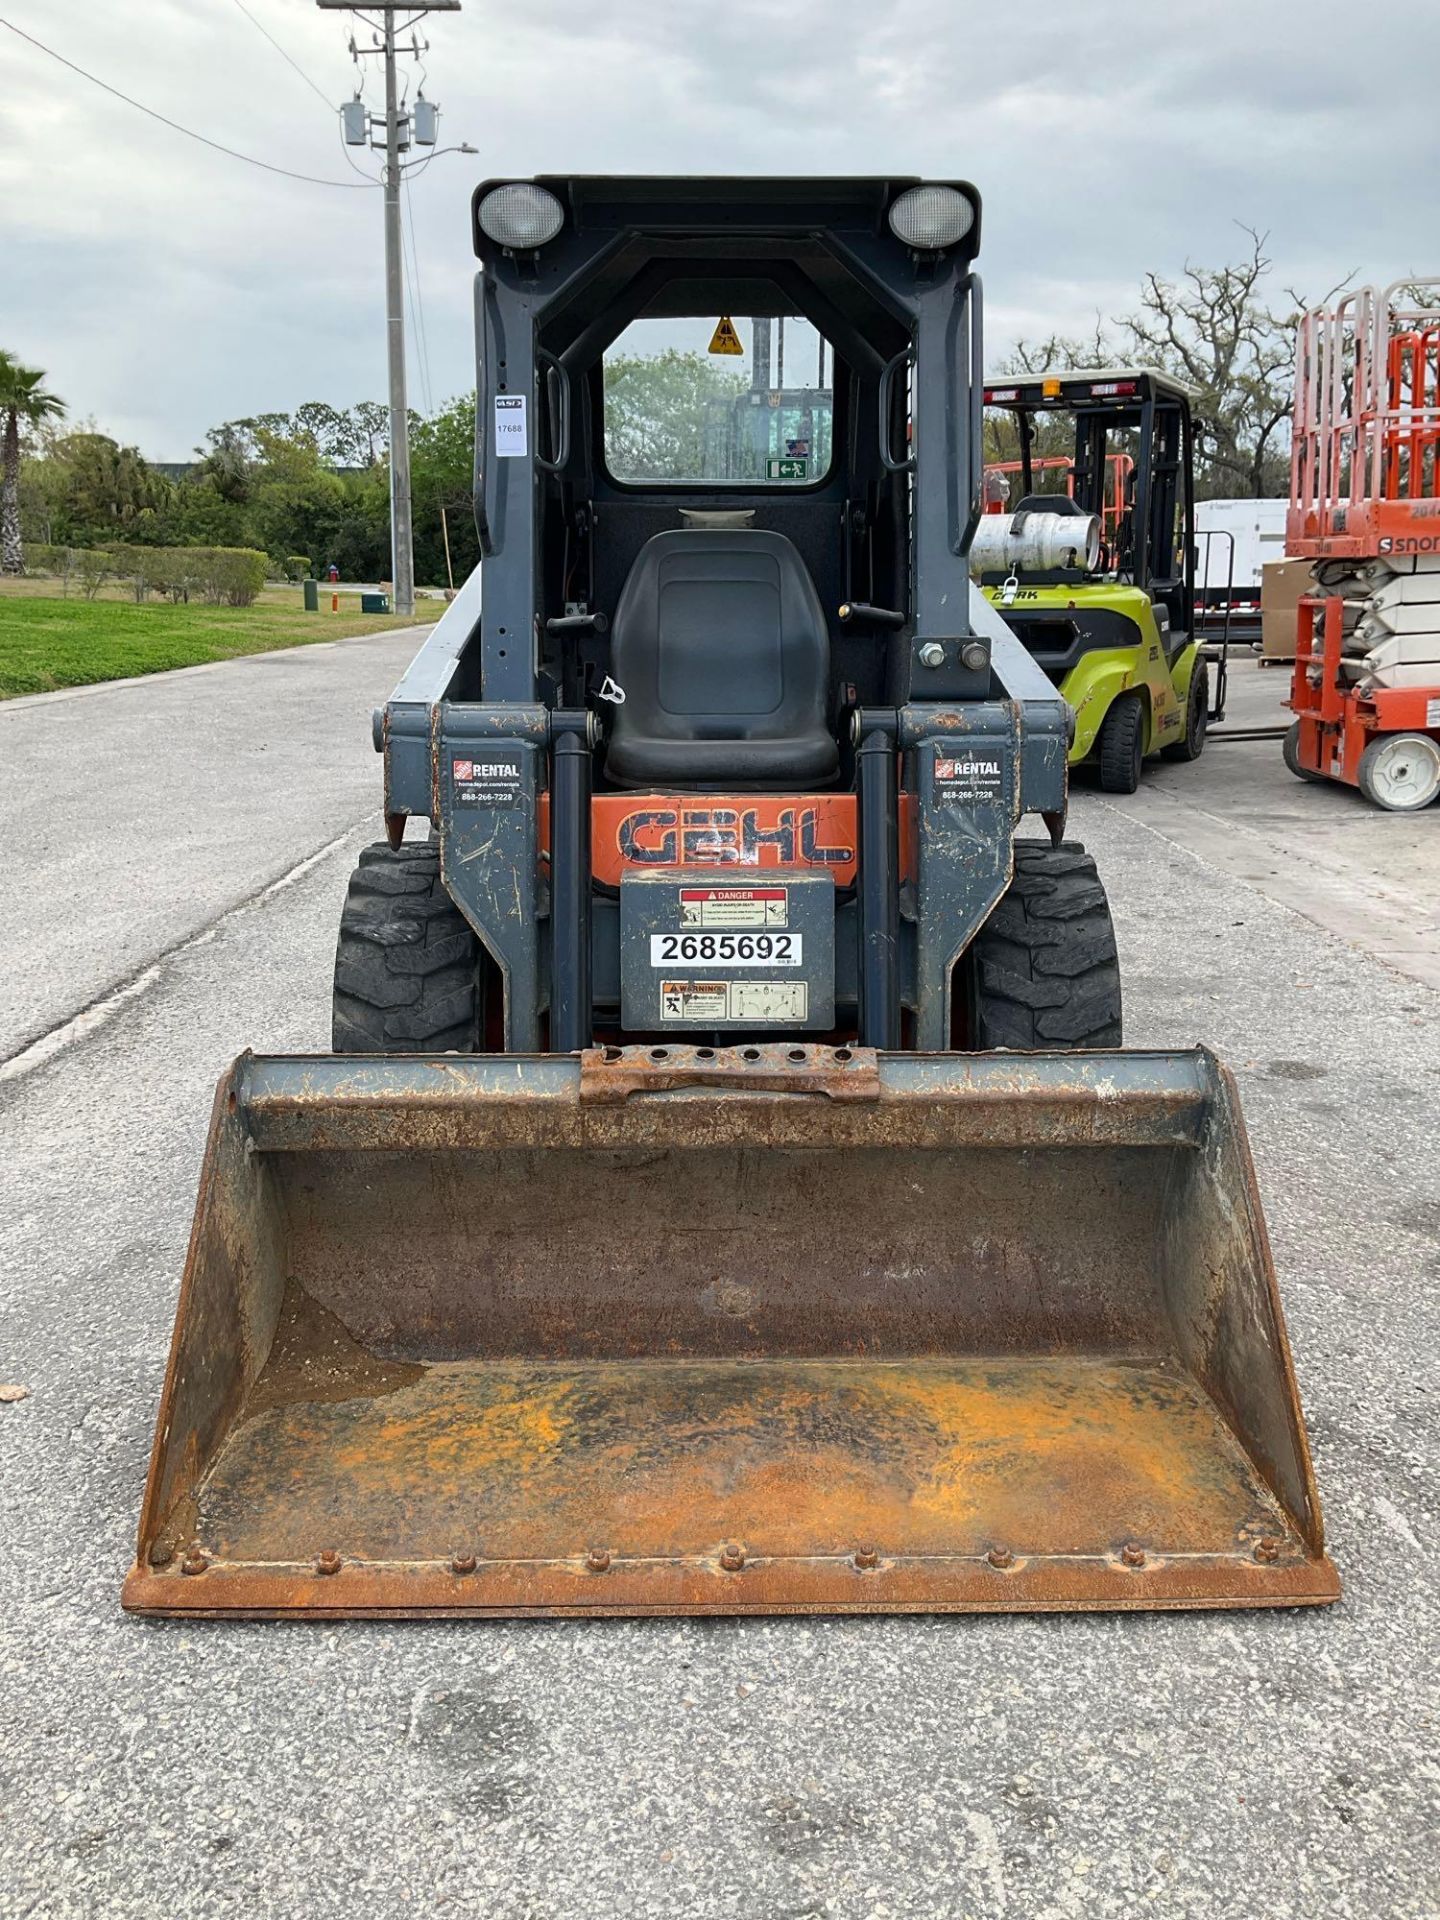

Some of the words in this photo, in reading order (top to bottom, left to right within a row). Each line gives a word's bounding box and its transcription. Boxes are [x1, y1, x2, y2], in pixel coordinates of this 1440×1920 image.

[498, 425, 522, 433] 17688
[992, 591, 1038, 600] CRK
[473, 764, 520, 777] RENTAL
[954, 762, 1001, 775] RENTAL
[461, 793, 513, 801] 888-266-7228
[616, 807, 854, 866] GEHL
[718, 892, 754, 900] DANGER
[660, 936, 792, 960] 2685692
[679, 985, 723, 993] WRNING
